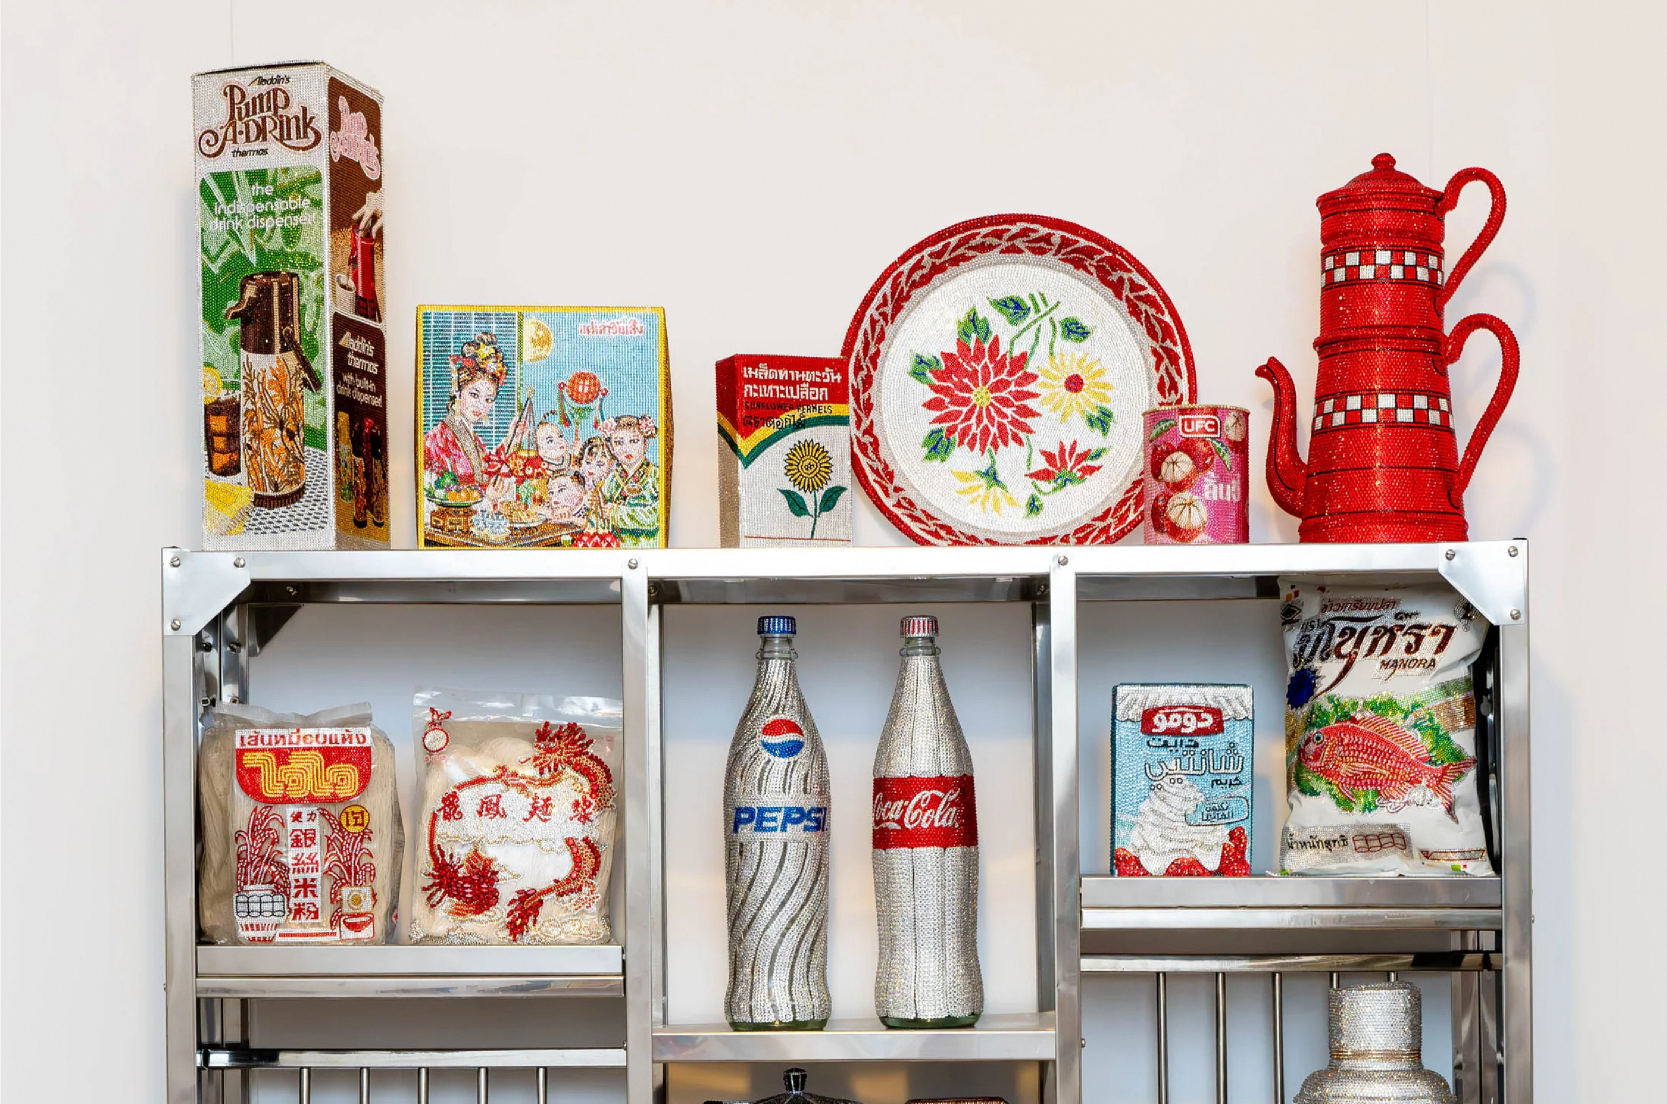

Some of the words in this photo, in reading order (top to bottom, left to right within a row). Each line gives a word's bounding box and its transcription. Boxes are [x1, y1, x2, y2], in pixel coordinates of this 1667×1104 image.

[231, 148, 268, 158] thermos
[251, 184, 274, 196] the
[214, 197, 312, 215] indispensable
[210, 217, 242, 232] drink
[347, 351, 379, 375] thermos
[743, 363, 842, 384] เมล็ดทานตะวัน
[744, 383, 829, 401] กะเทาะเปลือก
[1184, 420, 1216, 433] UFC
[1379, 657, 1437, 677] MANORA
[1152, 711, 1214, 733] دومو
[240, 728, 367, 747] เส้นหมี่อบแห้ง
[872, 788, 961, 830] Coca-Cola
[733, 806, 828, 834] PEPSI
